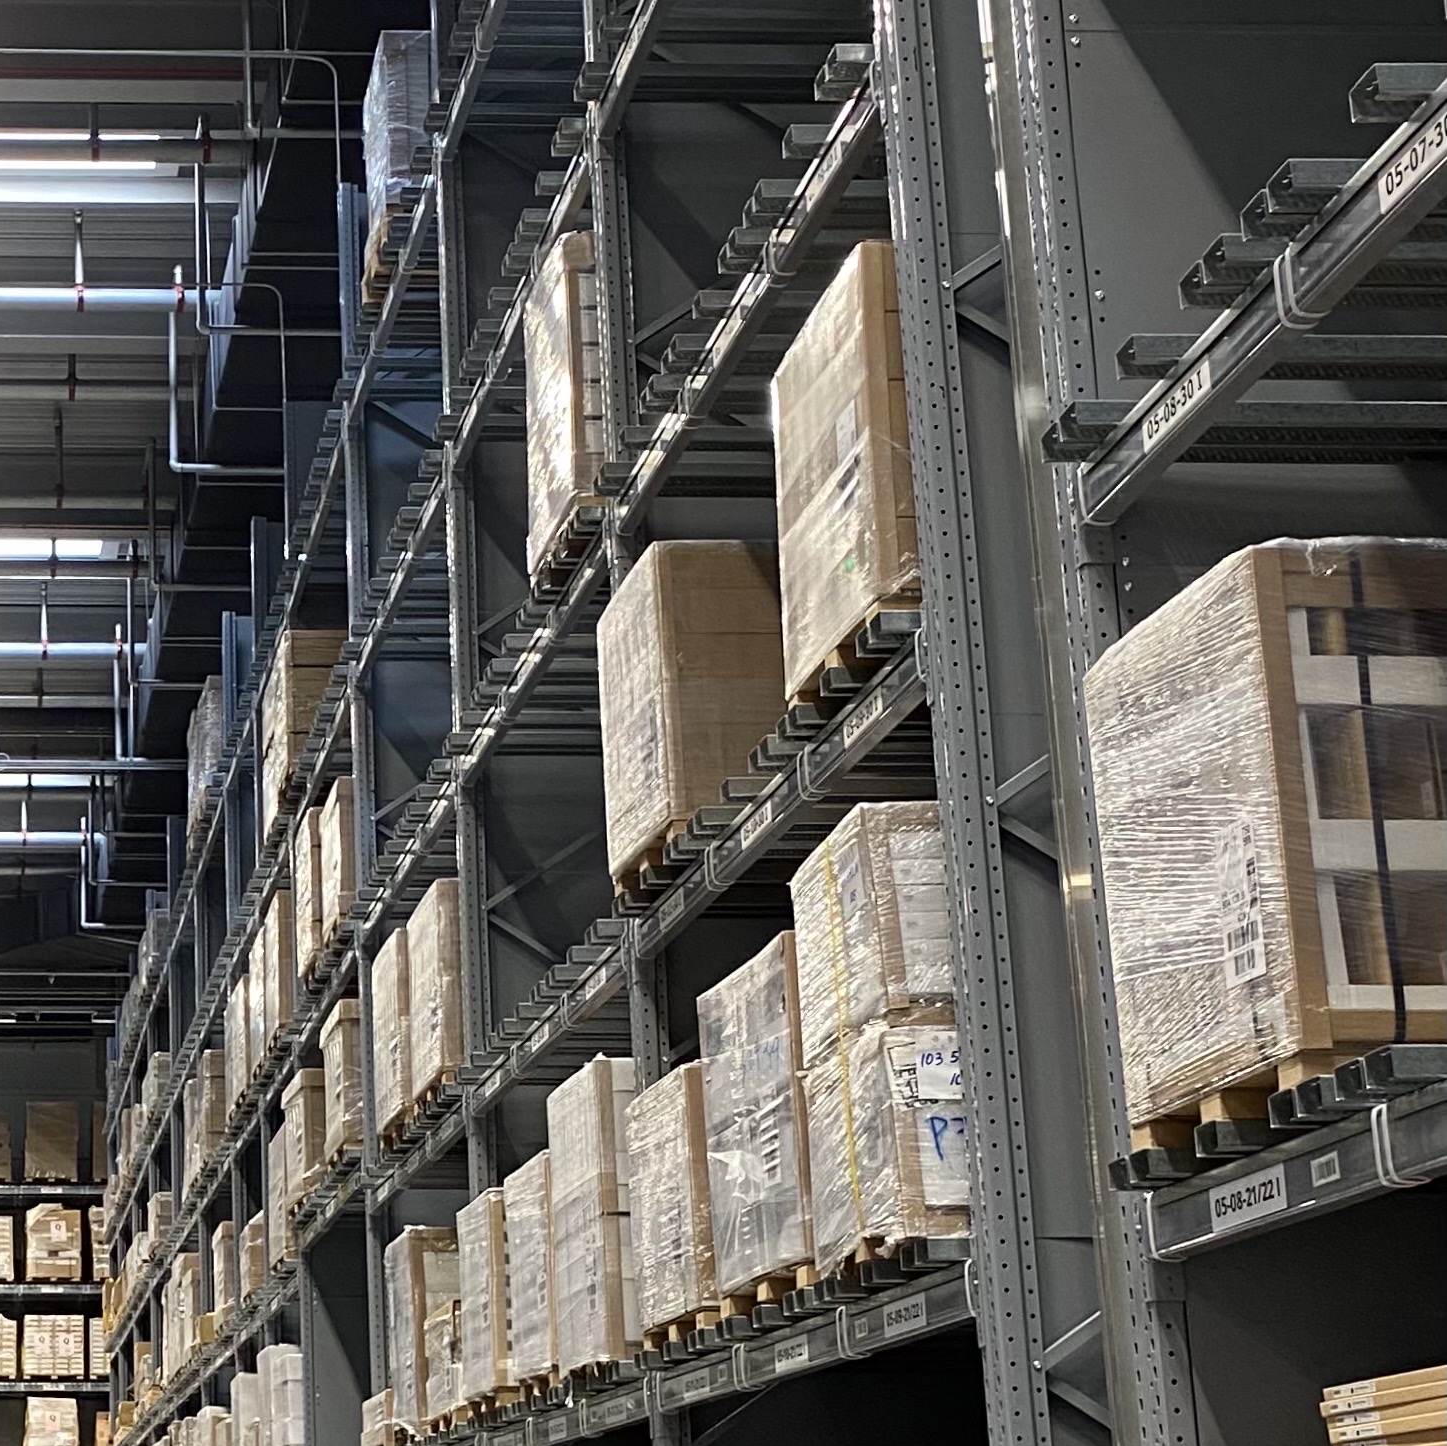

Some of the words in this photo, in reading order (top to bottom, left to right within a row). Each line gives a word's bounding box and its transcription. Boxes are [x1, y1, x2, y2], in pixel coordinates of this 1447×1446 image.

[1146, 379, 1194, 440] 05-08-30
[1196, 369, 1203, 392] I
[920, 1052, 944, 1068] 103
[1214, 1173, 1275, 1218] 05-08-21/22
